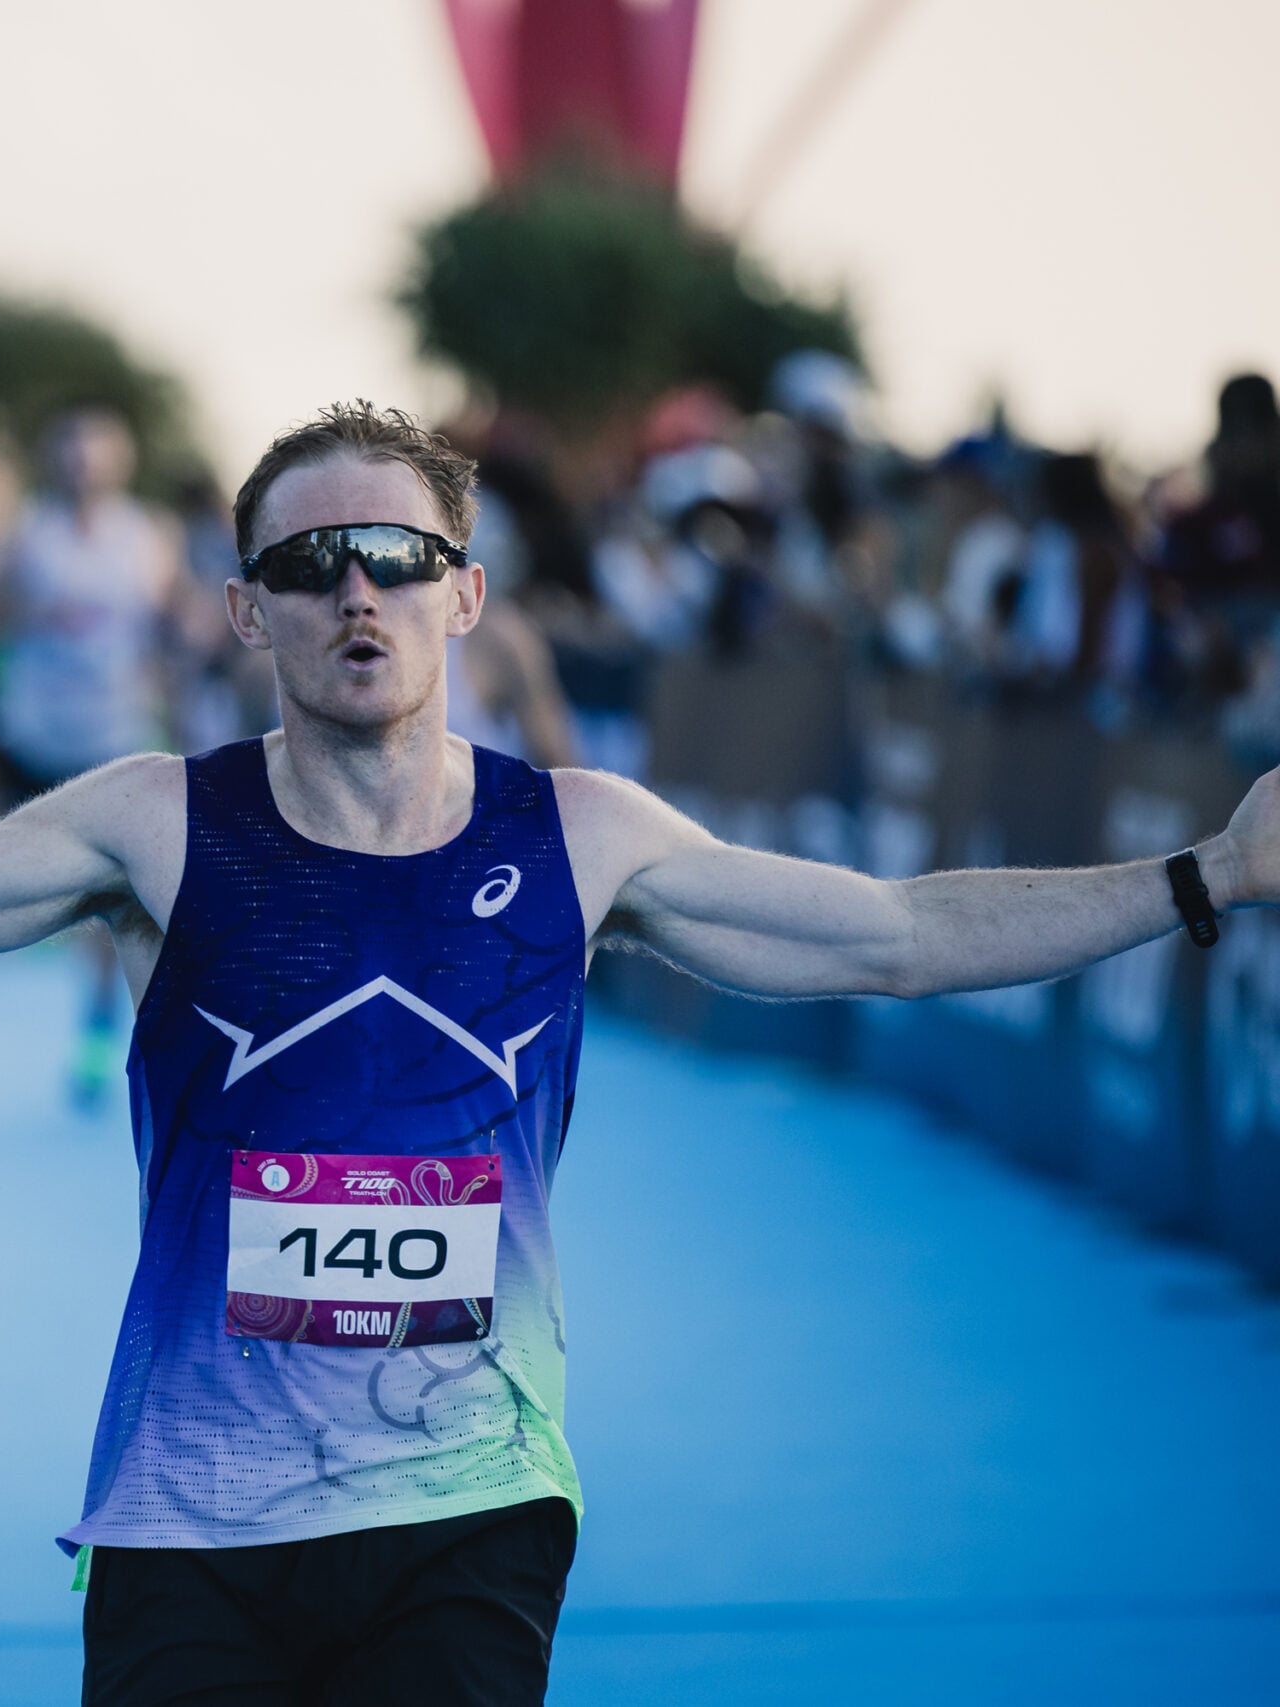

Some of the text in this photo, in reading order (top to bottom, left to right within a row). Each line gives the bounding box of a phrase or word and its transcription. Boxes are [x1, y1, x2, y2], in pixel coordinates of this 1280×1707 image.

[340, 1177, 396, 1190] T100
[279, 1227, 448, 1280] 140
[332, 1310, 392, 1336] 10KM
